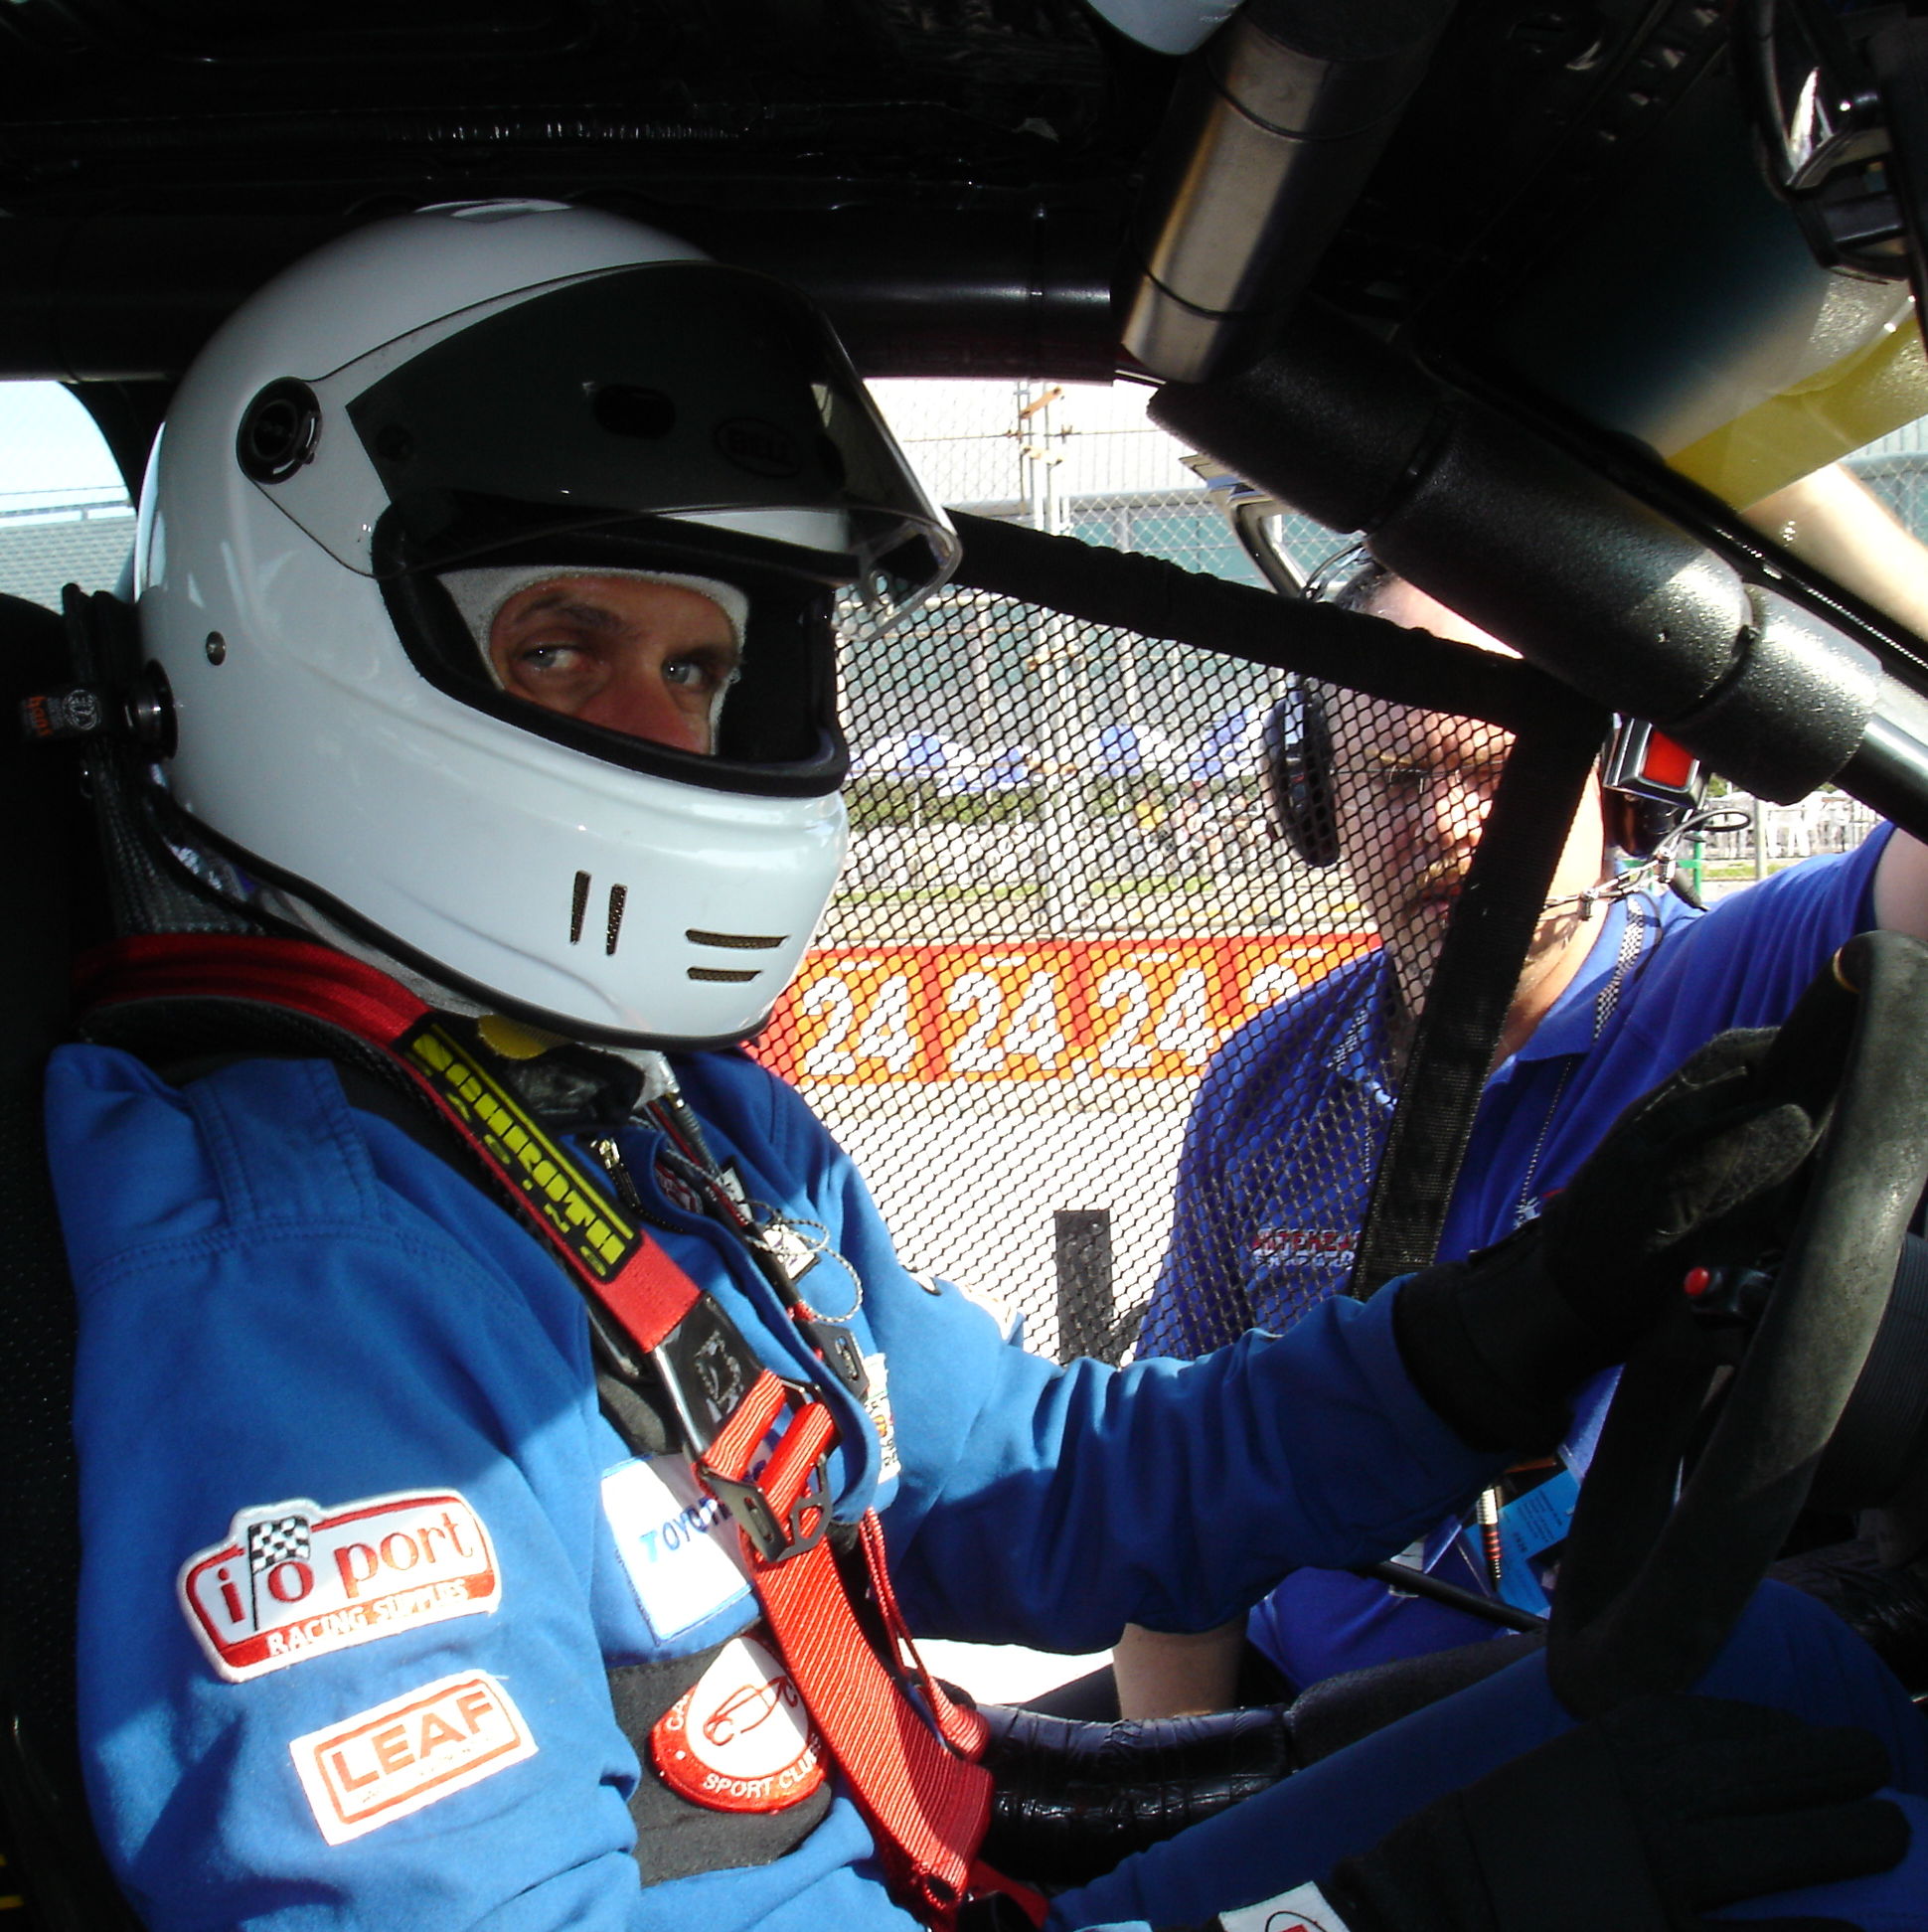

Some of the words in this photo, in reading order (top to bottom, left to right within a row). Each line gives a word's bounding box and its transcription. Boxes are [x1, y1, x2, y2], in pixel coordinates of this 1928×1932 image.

[802, 974, 916, 1076] 24
[949, 971, 1066, 1072] 24
[1099, 967, 1220, 1070] 24
[266, 1604, 370, 1658] RACING
[330, 1690, 494, 1793] LEAF
[703, 1772, 774, 1799] SPORT
